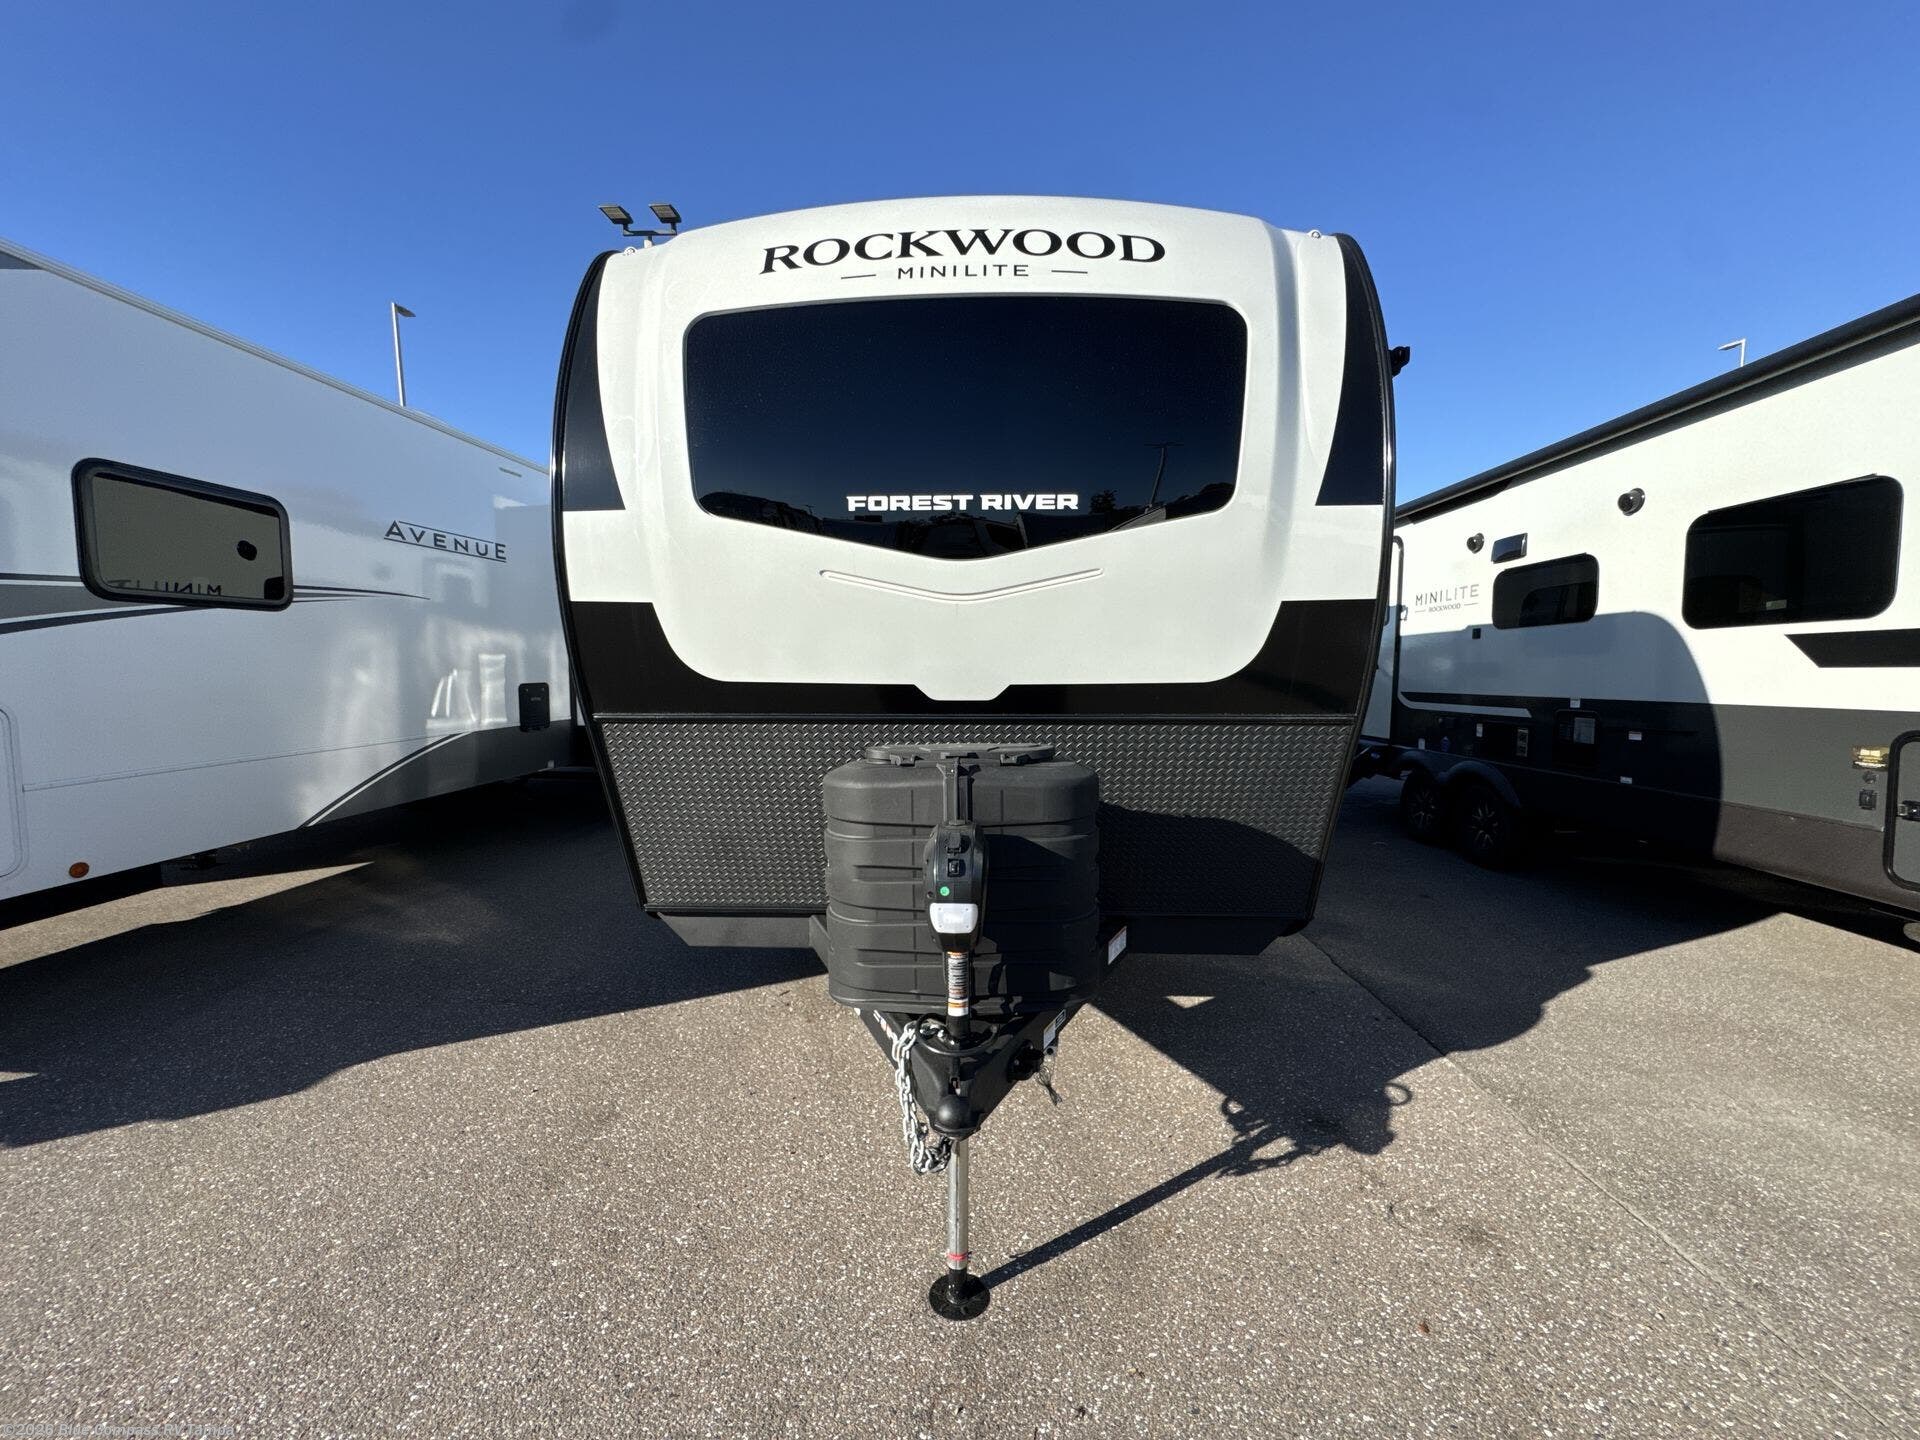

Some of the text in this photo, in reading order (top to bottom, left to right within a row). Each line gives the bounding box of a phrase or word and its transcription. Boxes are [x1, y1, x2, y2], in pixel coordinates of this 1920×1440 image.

[759, 228, 1166, 275] ROCKWOOD
[897, 264, 1029, 280] MINILITE
[846, 494, 1079, 512] FOREST RIVER
[385, 520, 507, 560] AVENUE
[1415, 583, 1480, 607] MINILITE
